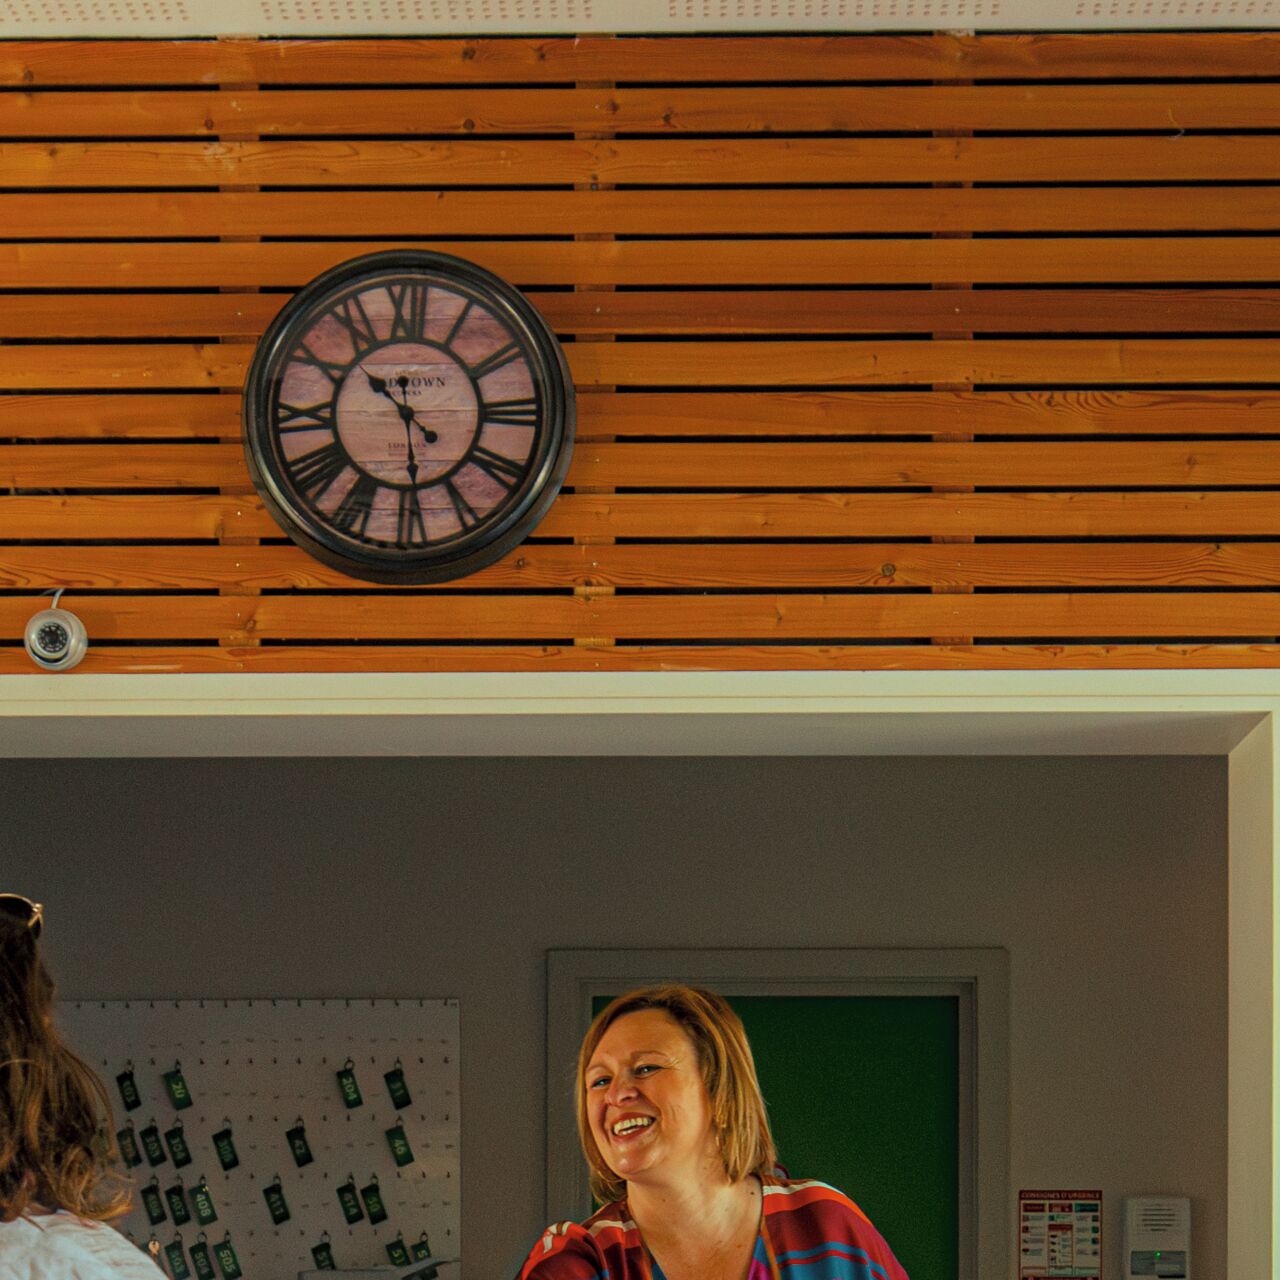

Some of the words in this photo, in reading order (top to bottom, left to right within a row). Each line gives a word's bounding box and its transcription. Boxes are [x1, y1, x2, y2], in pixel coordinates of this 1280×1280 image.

[402, 377, 445, 387] OWN
[342, 1076, 357, 1100] 204
[392, 1137, 407, 1156] 46
[194, 1192, 211, 1217] 408
[219, 1248, 236, 1273] 505
